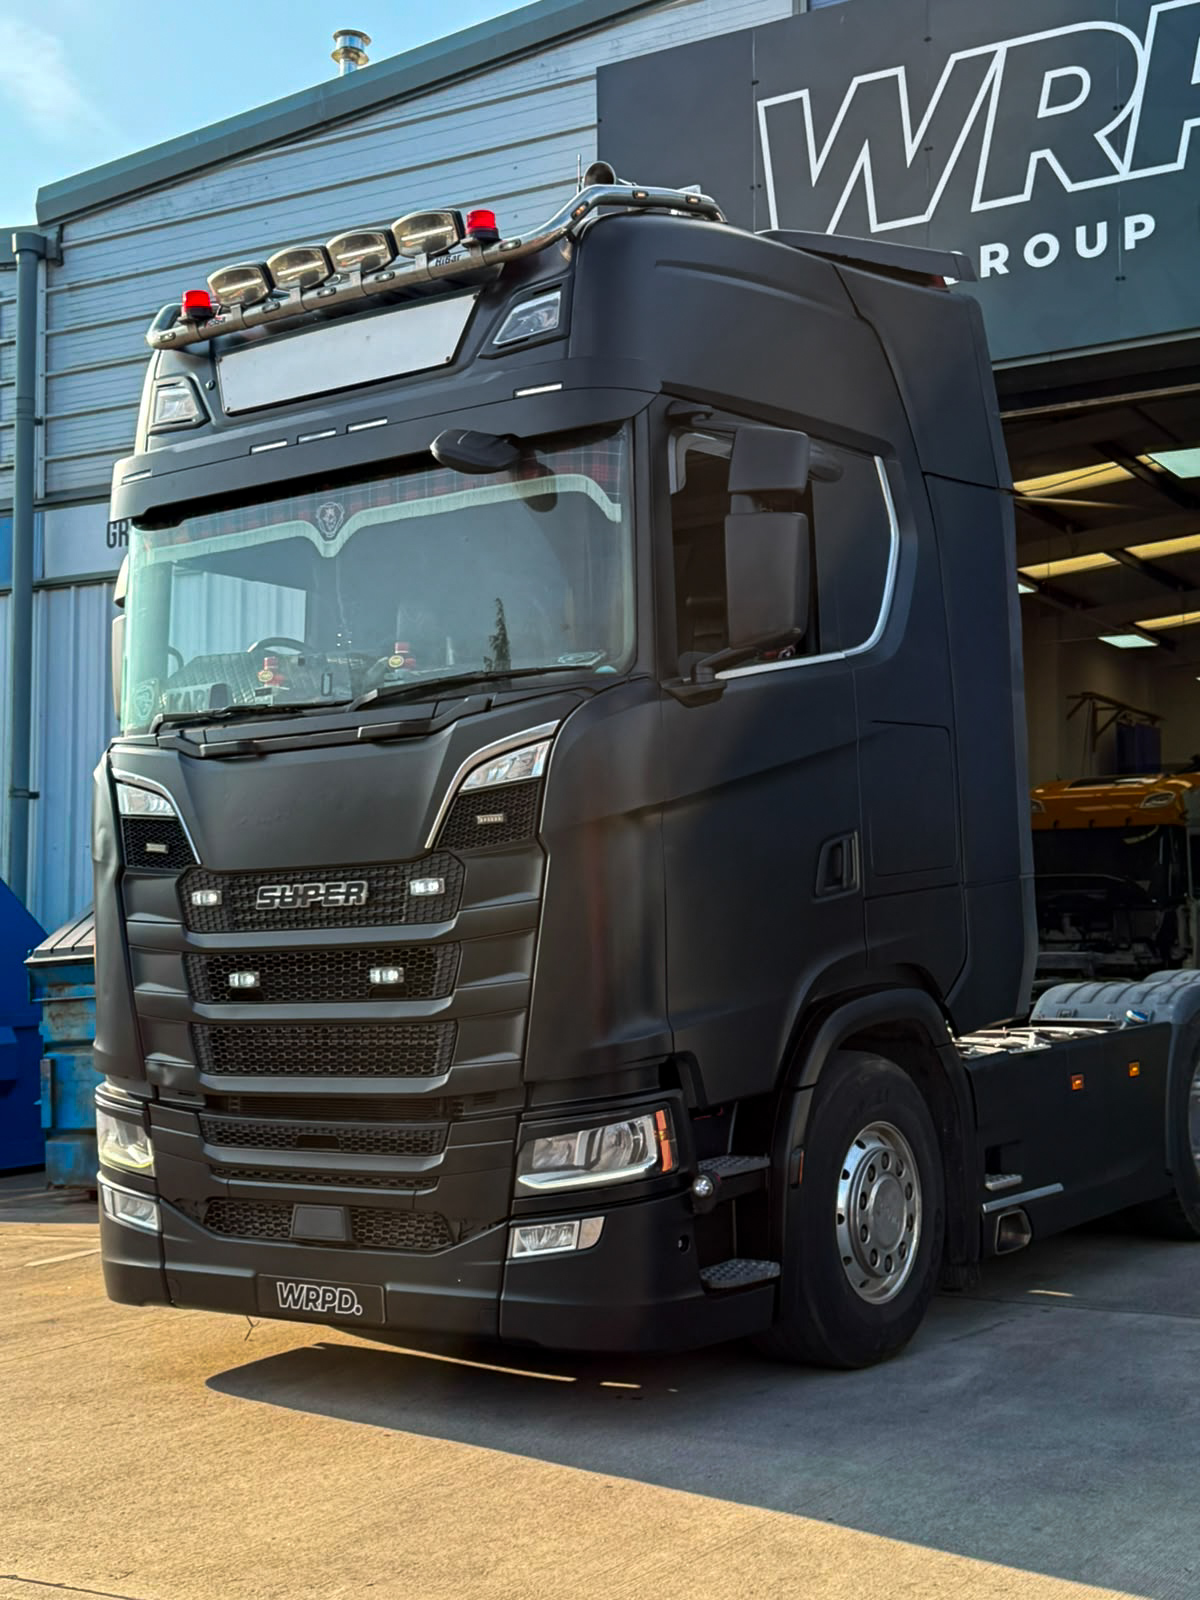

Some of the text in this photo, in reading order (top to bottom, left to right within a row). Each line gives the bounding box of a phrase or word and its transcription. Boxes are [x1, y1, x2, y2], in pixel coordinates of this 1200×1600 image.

[943, 213, 1156, 286] ROUP
[256, 881, 368, 910] SUPER
[276, 1282, 363, 1316] WRPD.
